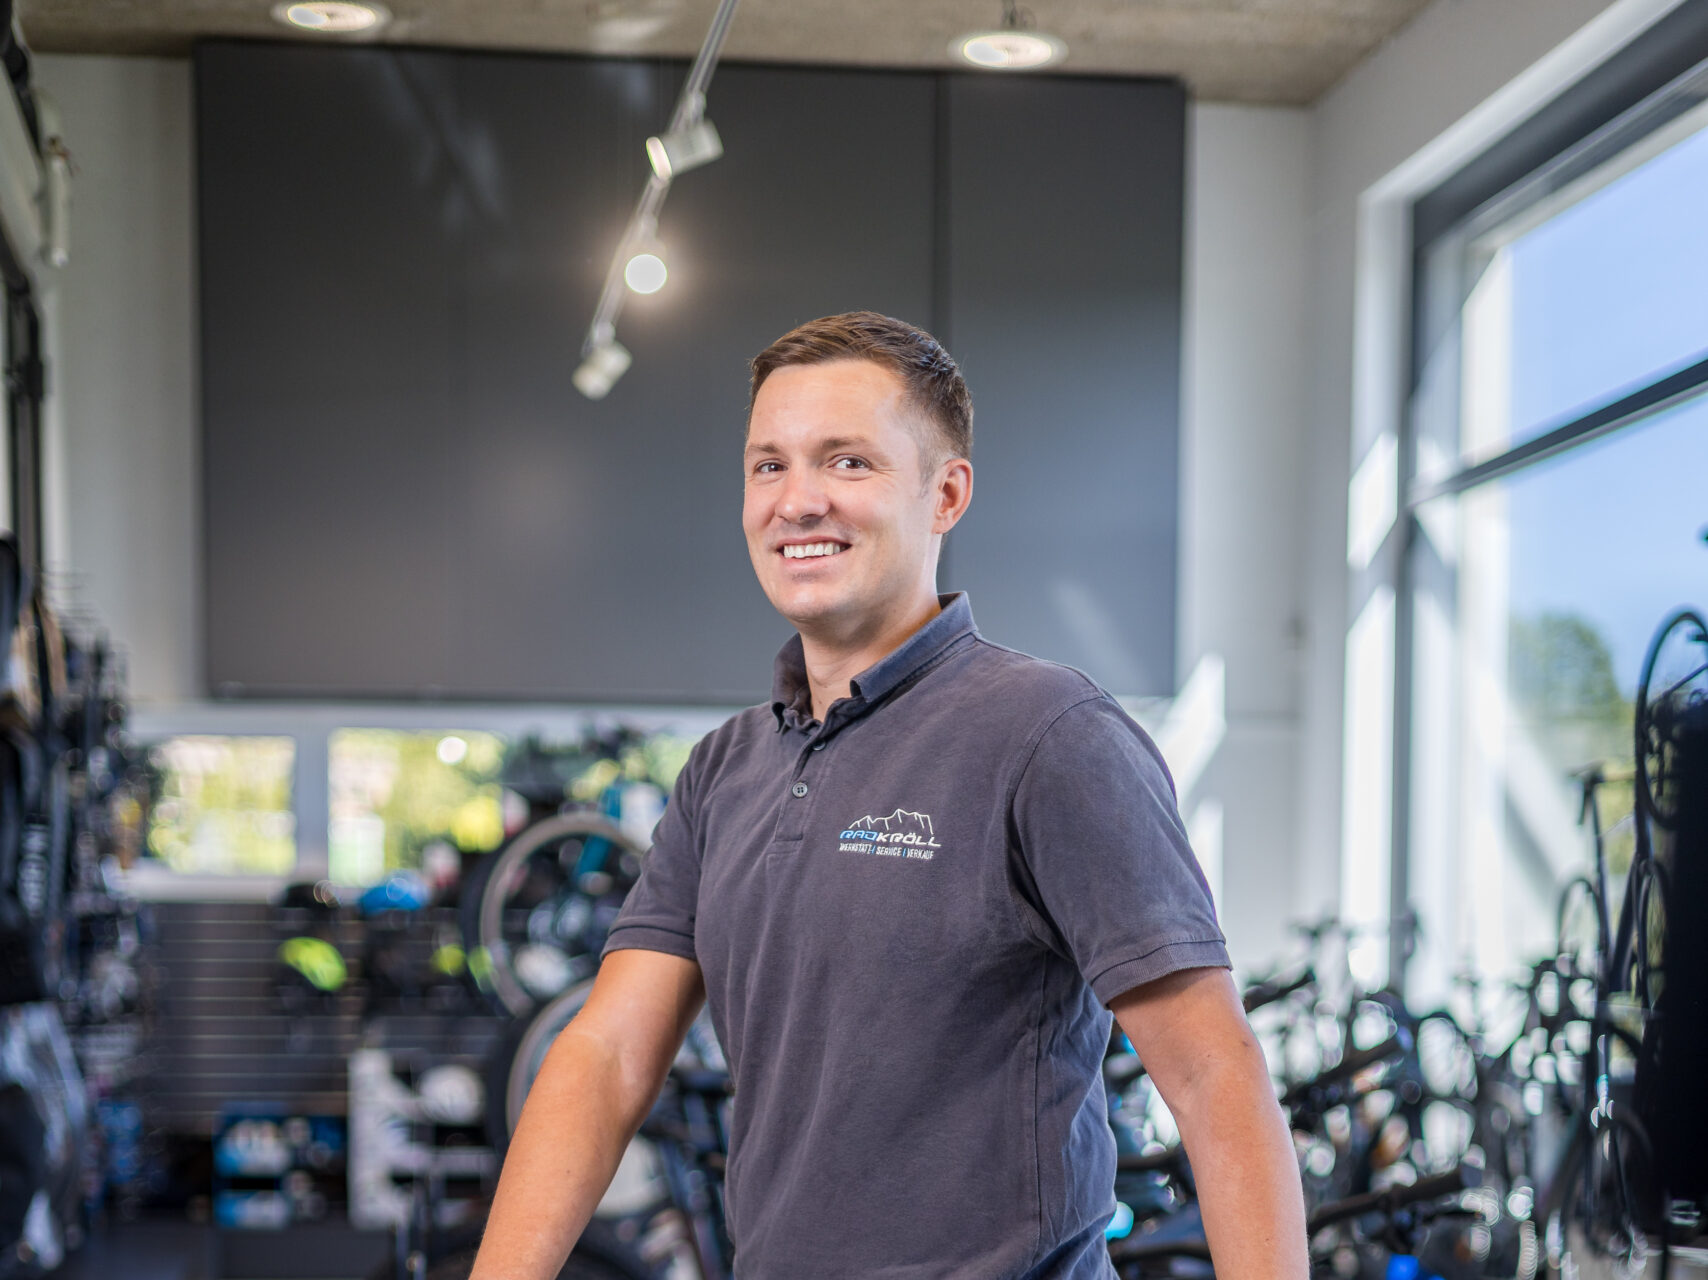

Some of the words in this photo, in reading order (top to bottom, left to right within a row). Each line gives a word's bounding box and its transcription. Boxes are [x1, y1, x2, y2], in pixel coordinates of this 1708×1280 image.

[840, 829, 941, 848] RADKRÖLL
[875, 846, 902, 857] SERVICE
[906, 848, 935, 860] VERKAUF
